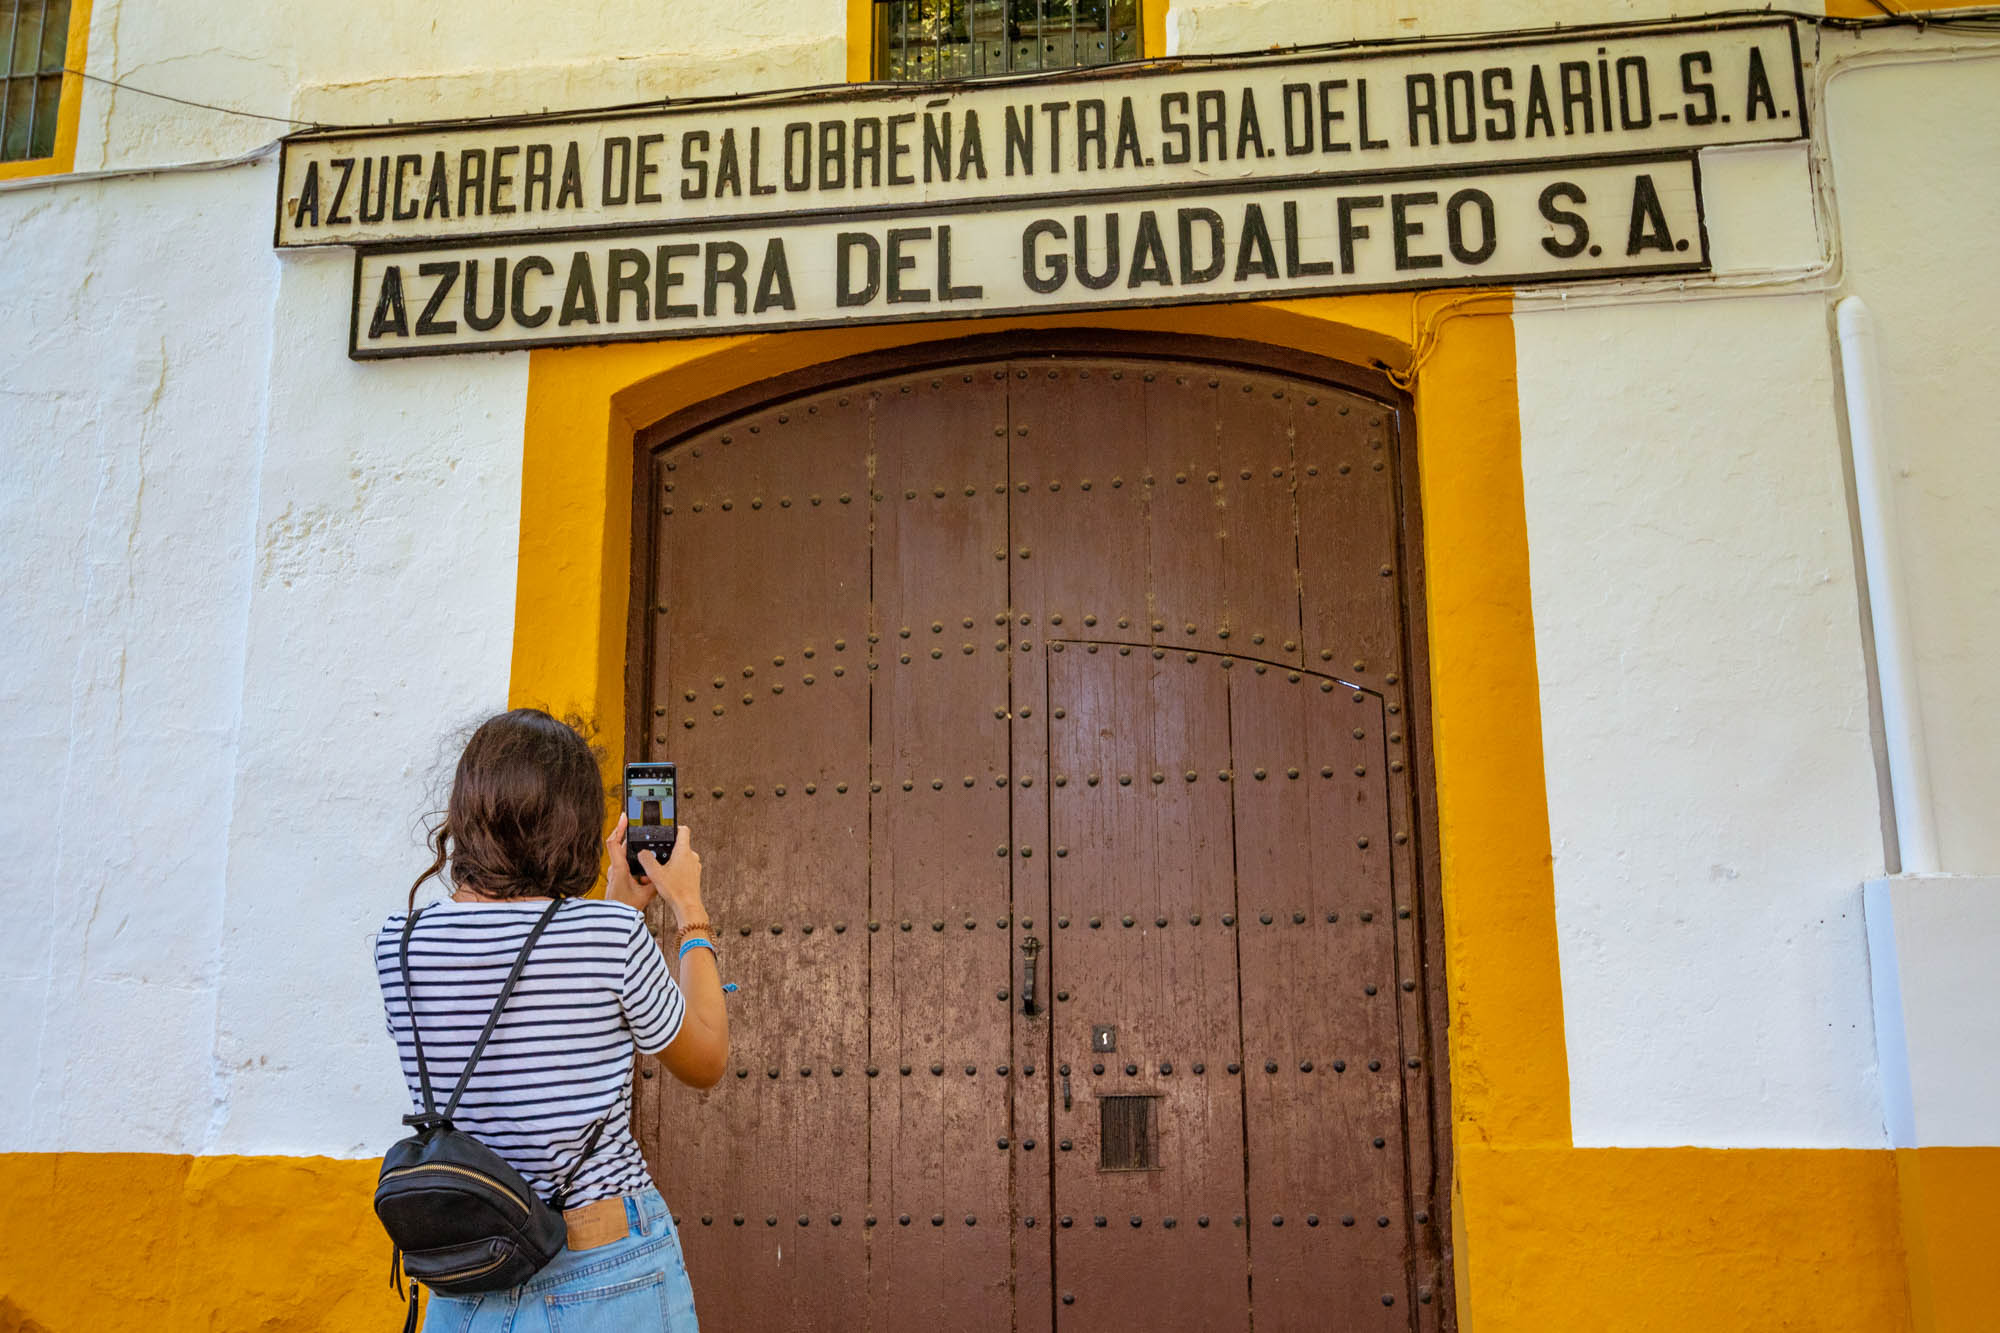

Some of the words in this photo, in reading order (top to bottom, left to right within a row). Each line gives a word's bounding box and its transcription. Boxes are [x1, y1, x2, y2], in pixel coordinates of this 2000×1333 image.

[294, 141, 584, 229] AZUCARERA
[601, 133, 664, 207] DE
[680, 98, 988, 200] SALOBREÑA
[368, 237, 796, 339] AZUCARERA
[836, 224, 983, 307] DEL
[1022, 188, 1497, 294] GUADALFEO
